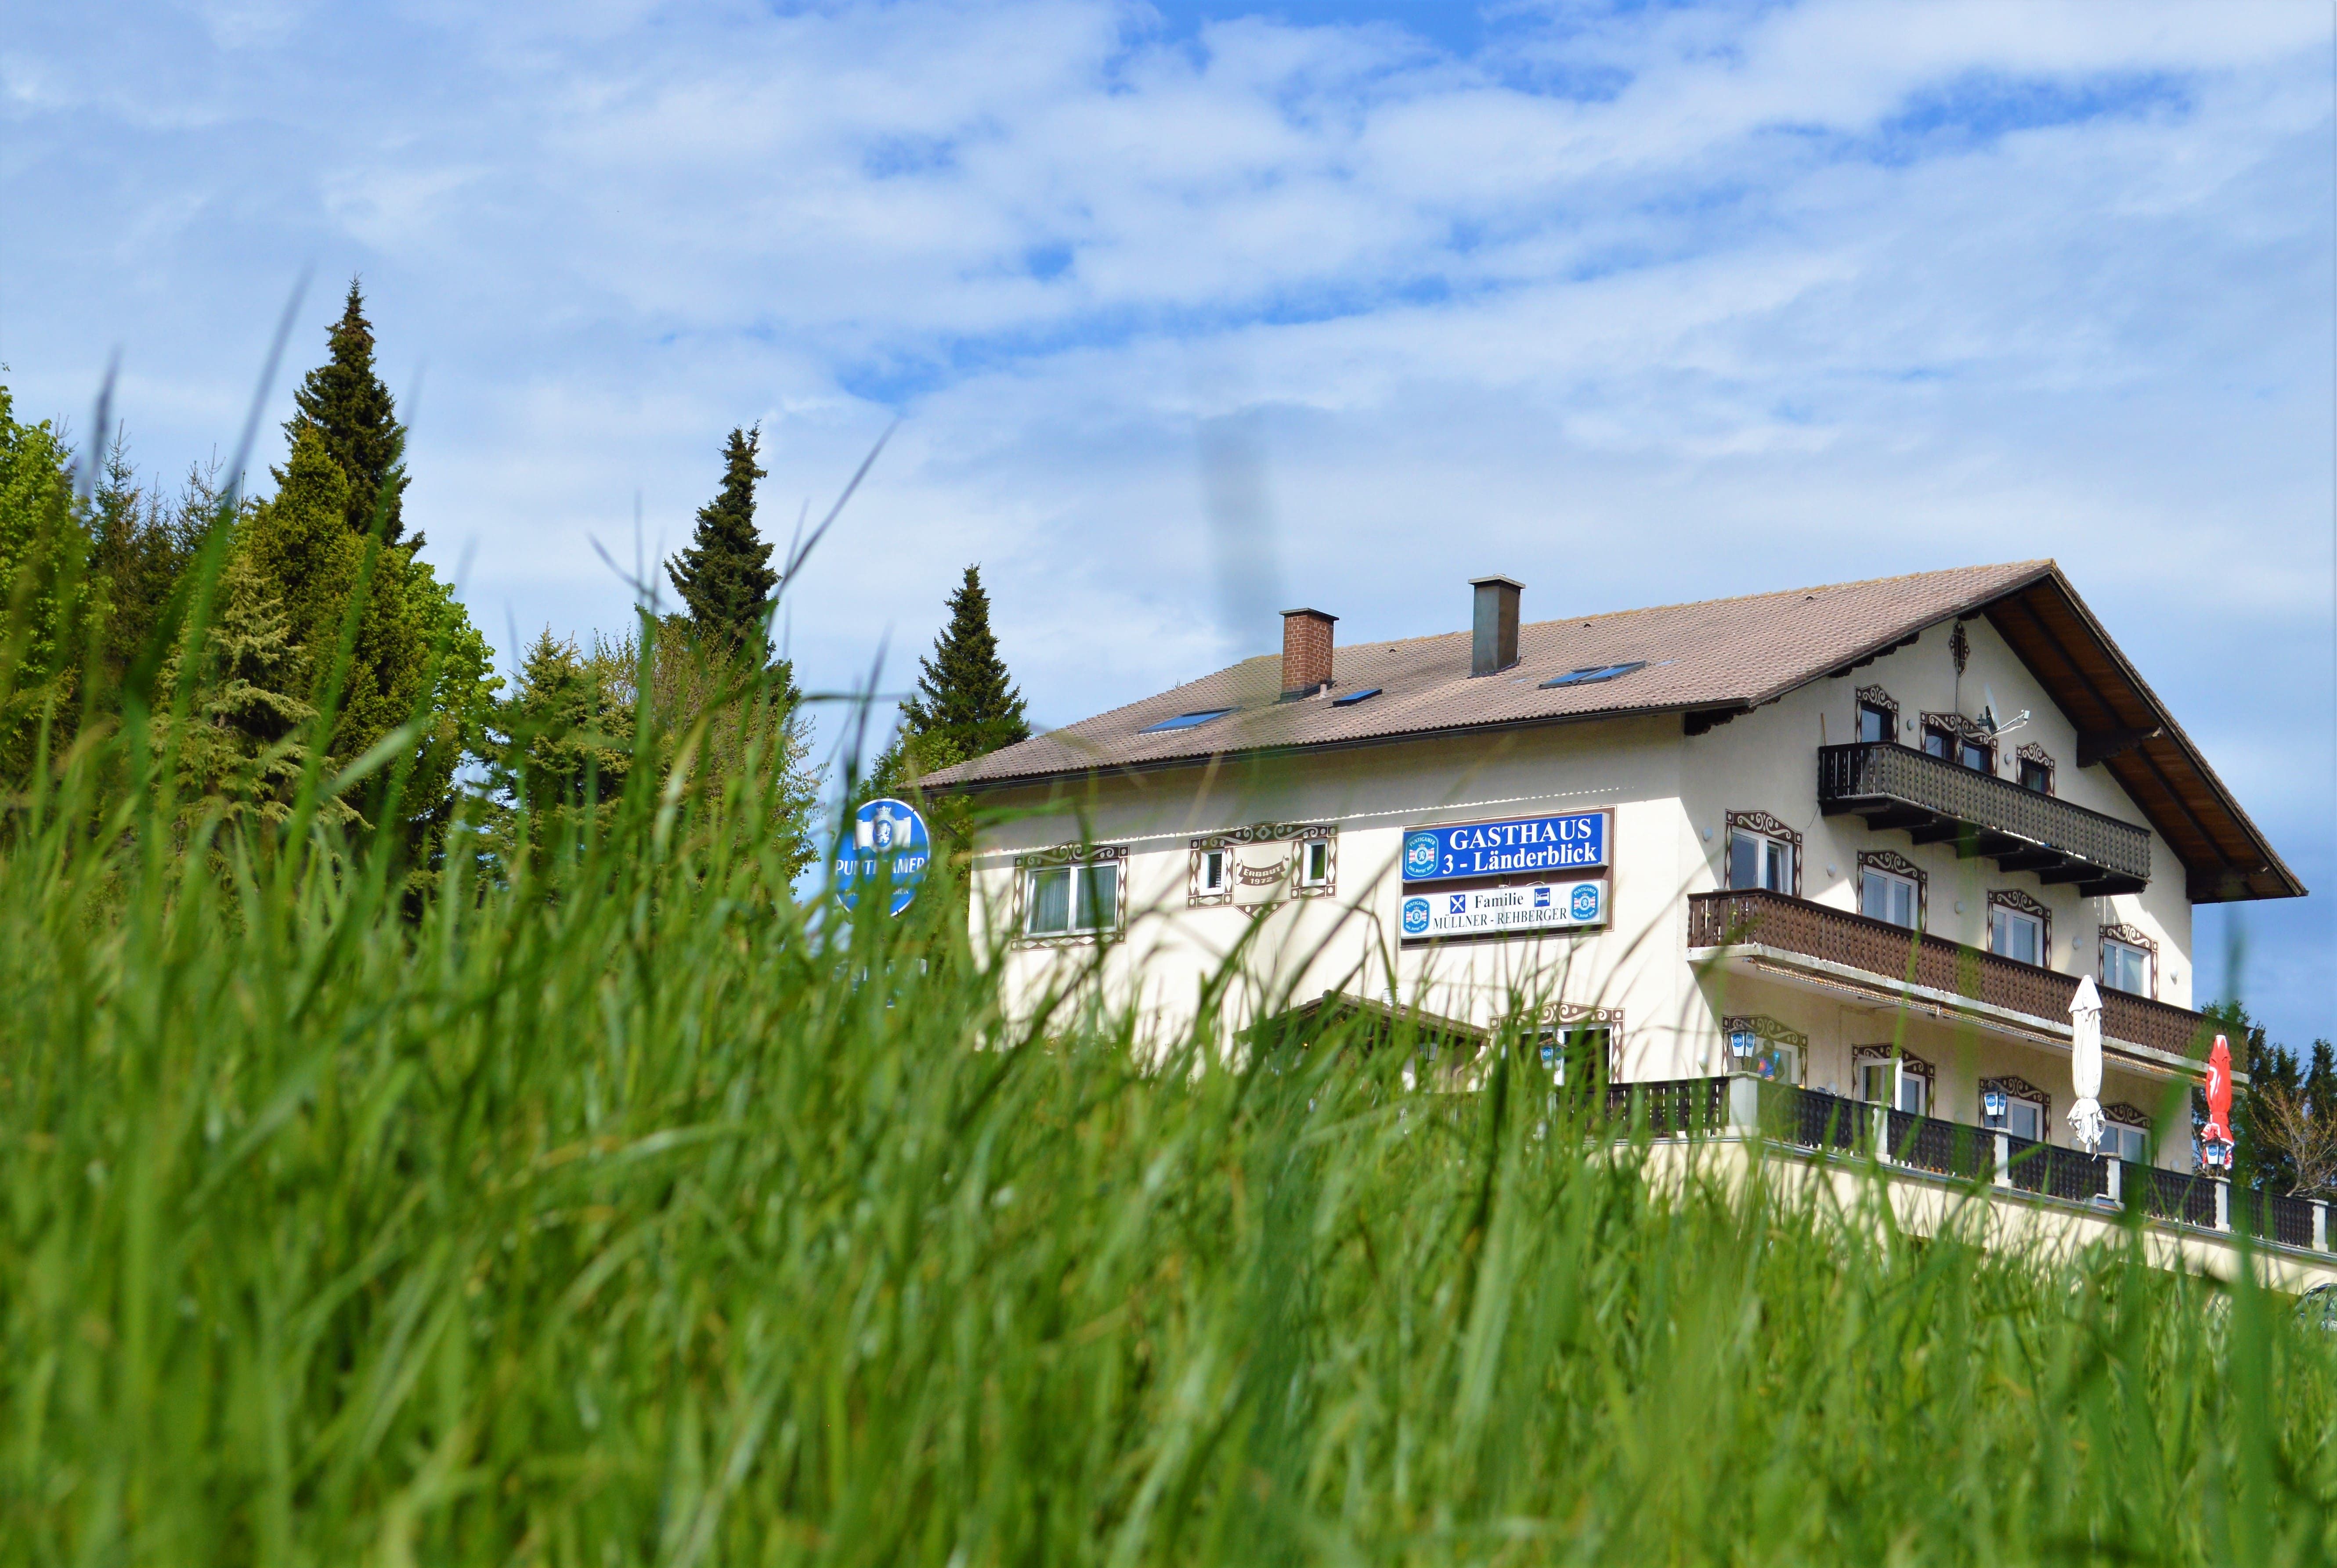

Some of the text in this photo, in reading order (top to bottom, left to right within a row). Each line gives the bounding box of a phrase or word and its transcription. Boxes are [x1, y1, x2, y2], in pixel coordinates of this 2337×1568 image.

[1449, 818, 1591, 850] GASTHAUS
[1442, 854, 1454, 874] 3
[1473, 842, 1597, 872] Länderblick
[1243, 866, 1281, 877] ERBAUT
[1475, 892, 1524, 908] Familie
[1433, 913, 1488, 930] MÜLLNER
[1497, 908, 1567, 925] REHBERGER
